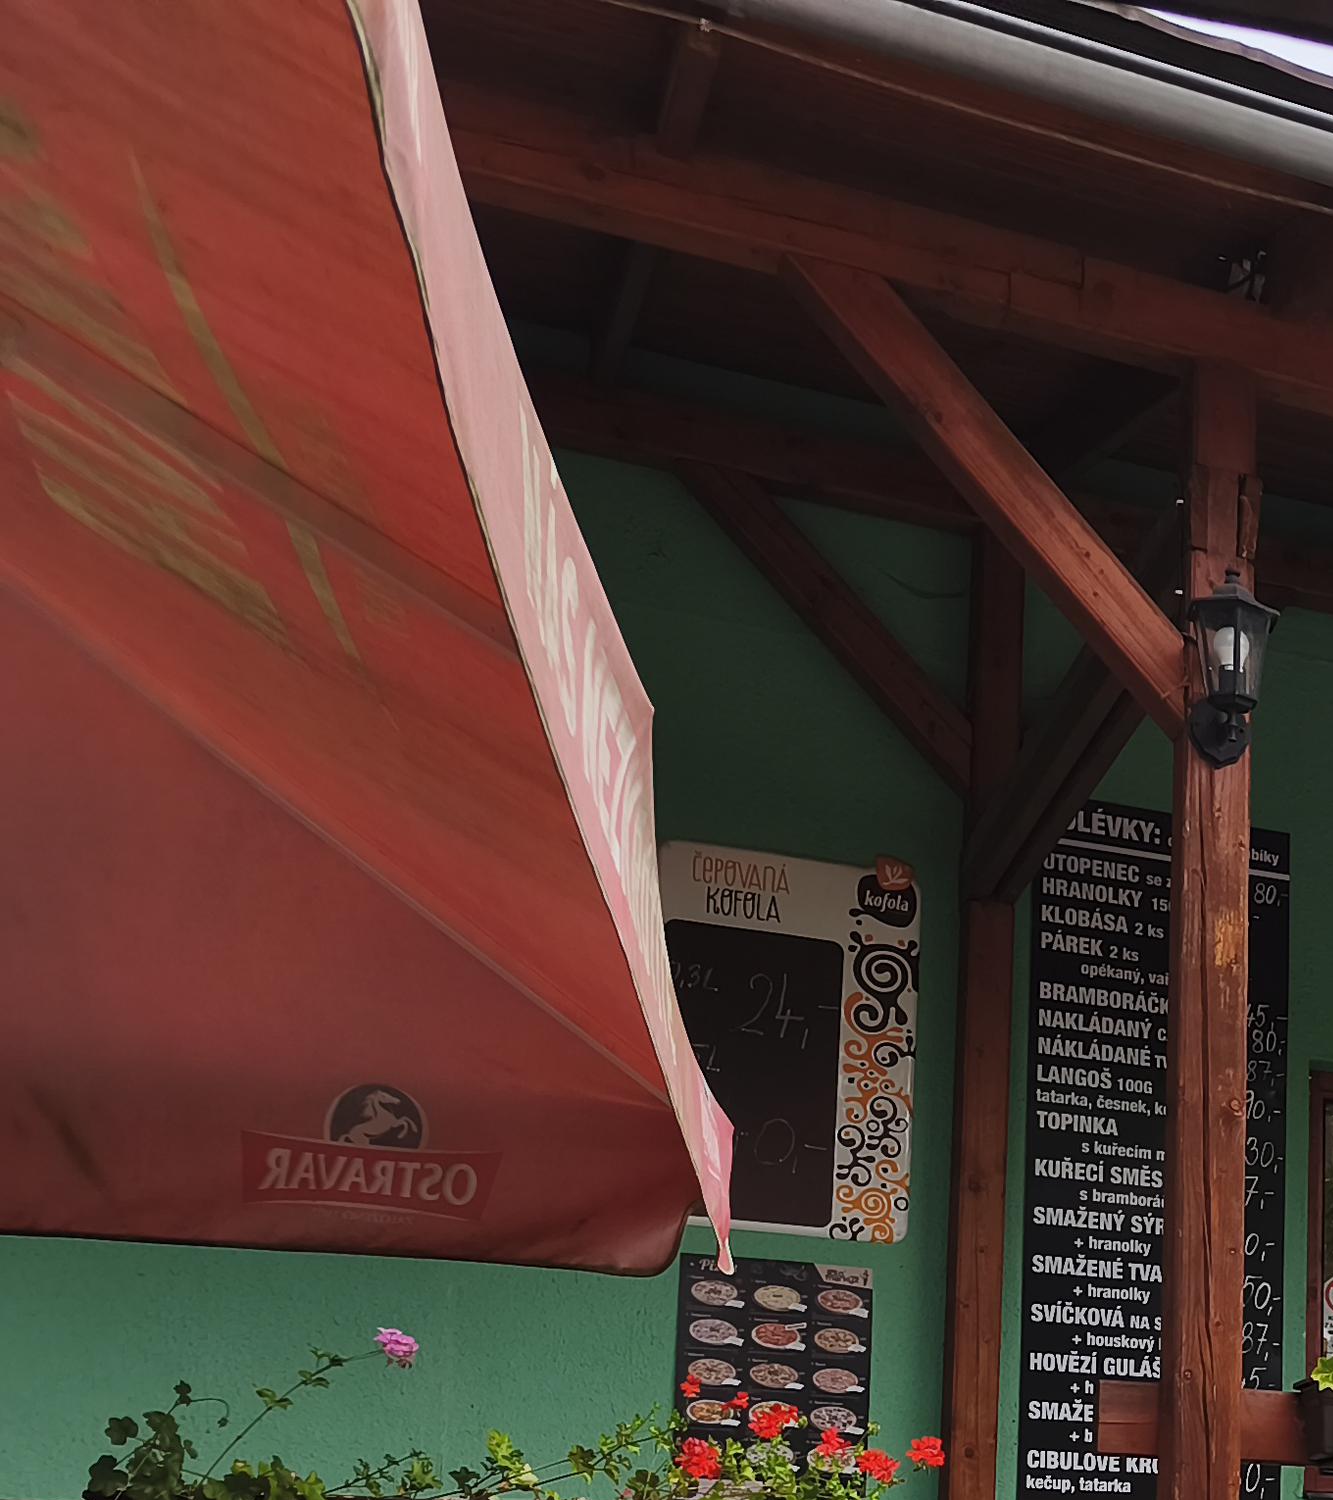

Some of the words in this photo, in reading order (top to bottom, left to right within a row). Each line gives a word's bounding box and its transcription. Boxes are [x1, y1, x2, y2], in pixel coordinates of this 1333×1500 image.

[1043, 853, 1140, 883] UTOPENEC
[706, 885, 781, 923] KOFOLA
[865, 890, 909, 913] kofola
[1042, 877, 1143, 908] HRANOLKY
[1151, 897, 1171, 912] 15
[1041, 904, 1129, 934] KLOBÁSA
[1134, 922, 1143, 936] 2
[1147, 924, 1165, 938] ks
[1041, 930, 1103, 957] PÁREK
[1109, 945, 1119, 959] 2
[1122, 947, 1139, 961] ks
[1038, 1008, 1152, 1039] NAKLÁDANÝ
[1037, 1064, 1112, 1089] LANGOŠ
[1117, 1078, 1153, 1095] 100G
[1036, 1088, 1092, 1110] tatarka,
[1096, 1095, 1151, 1117] česnek,
[1036, 1110, 1118, 1136] TOPINKA
[1081, 1142, 1090, 1153] s
[1093, 1141, 1152, 1160] kuřecím
[1034, 1156, 1104, 1182] KUŘECÍ
[1079, 1189, 1088, 1201] s
[1033, 1205, 1125, 1232] SMAŽENÝ
[1089, 1236, 1151, 1257] hranolky
[1032, 1254, 1124, 1280] SMAŽENÉ
[1088, 1283, 1151, 1305] hranolky
[1031, 1300, 1125, 1328] SVÍČKOVÁ
[1130, 1315, 1150, 1330] NA
[1087, 1332, 1155, 1352] houskový
[1029, 1350, 1098, 1374] HOVĚZÍ
[1025, 1474, 1076, 1493] kečup,
[1079, 1477, 1131, 1493] tatarka
